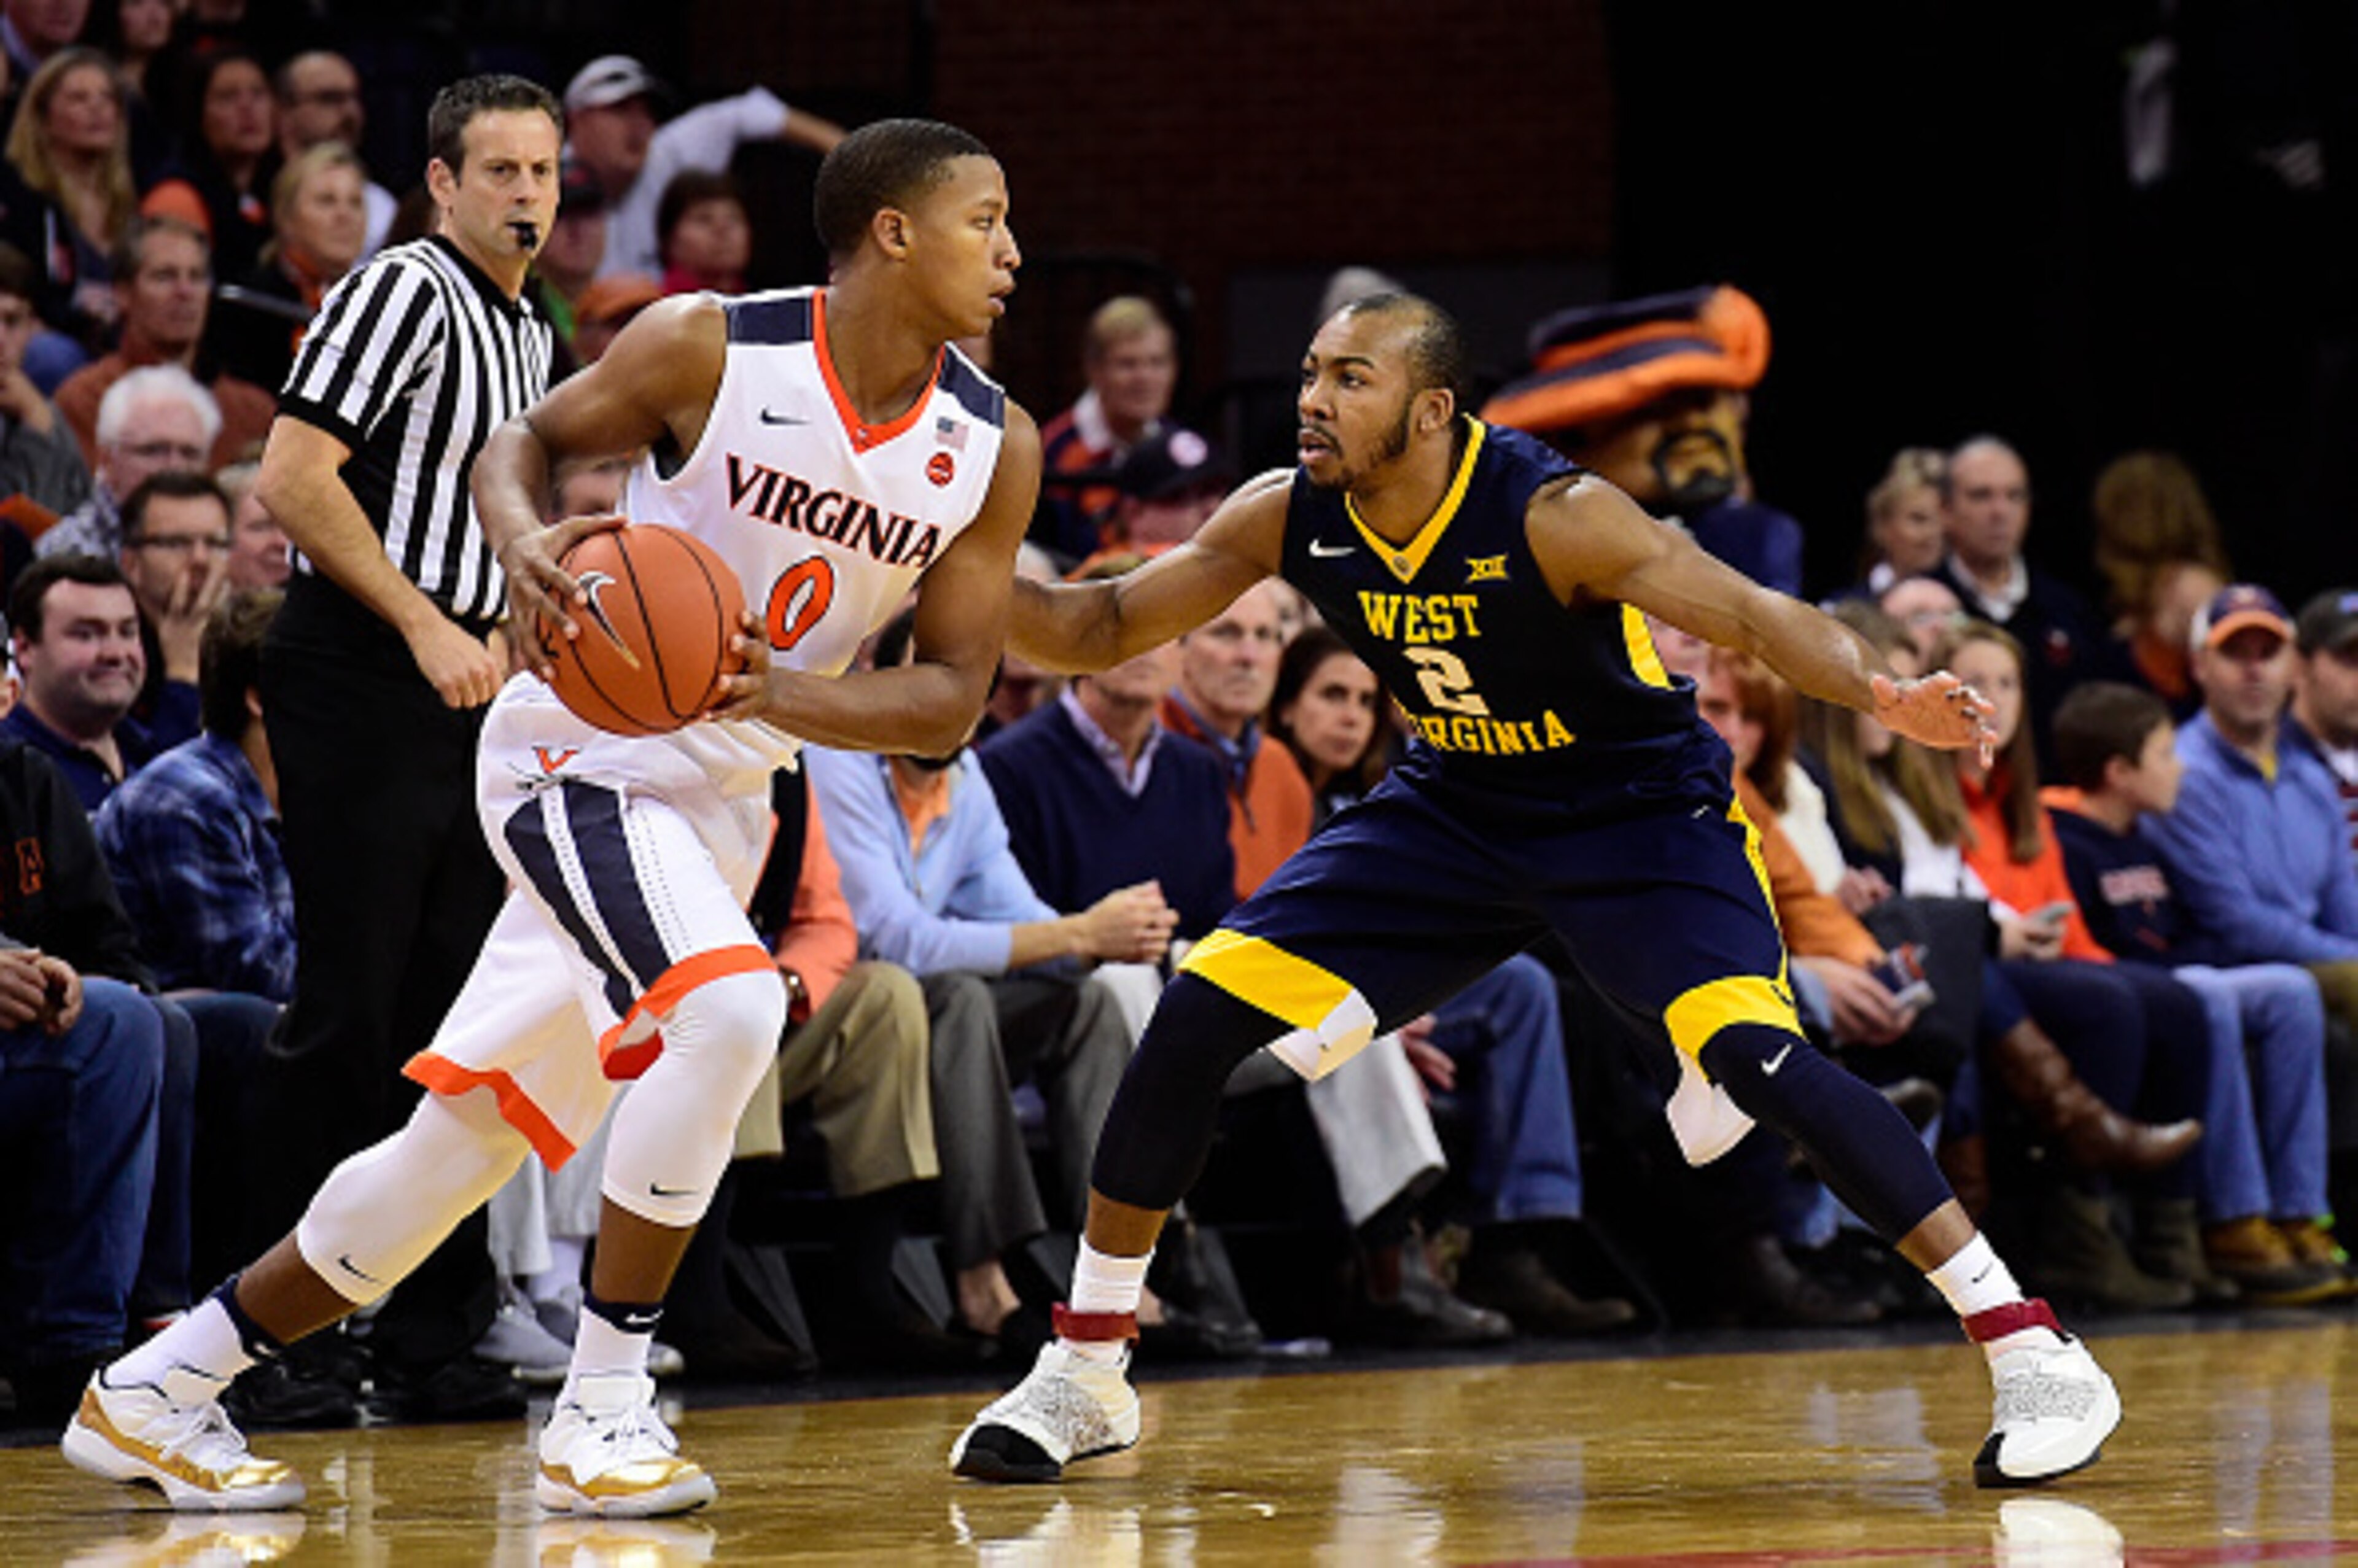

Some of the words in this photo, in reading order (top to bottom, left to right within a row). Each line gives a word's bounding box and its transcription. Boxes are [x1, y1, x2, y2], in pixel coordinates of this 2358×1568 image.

[726, 453, 940, 568] VIRGINIA
[767, 556, 835, 651] 0
[1357, 591, 1481, 643] WEST
[1403, 646, 1490, 715] 2
[1405, 710, 1576, 755] RGINIA
